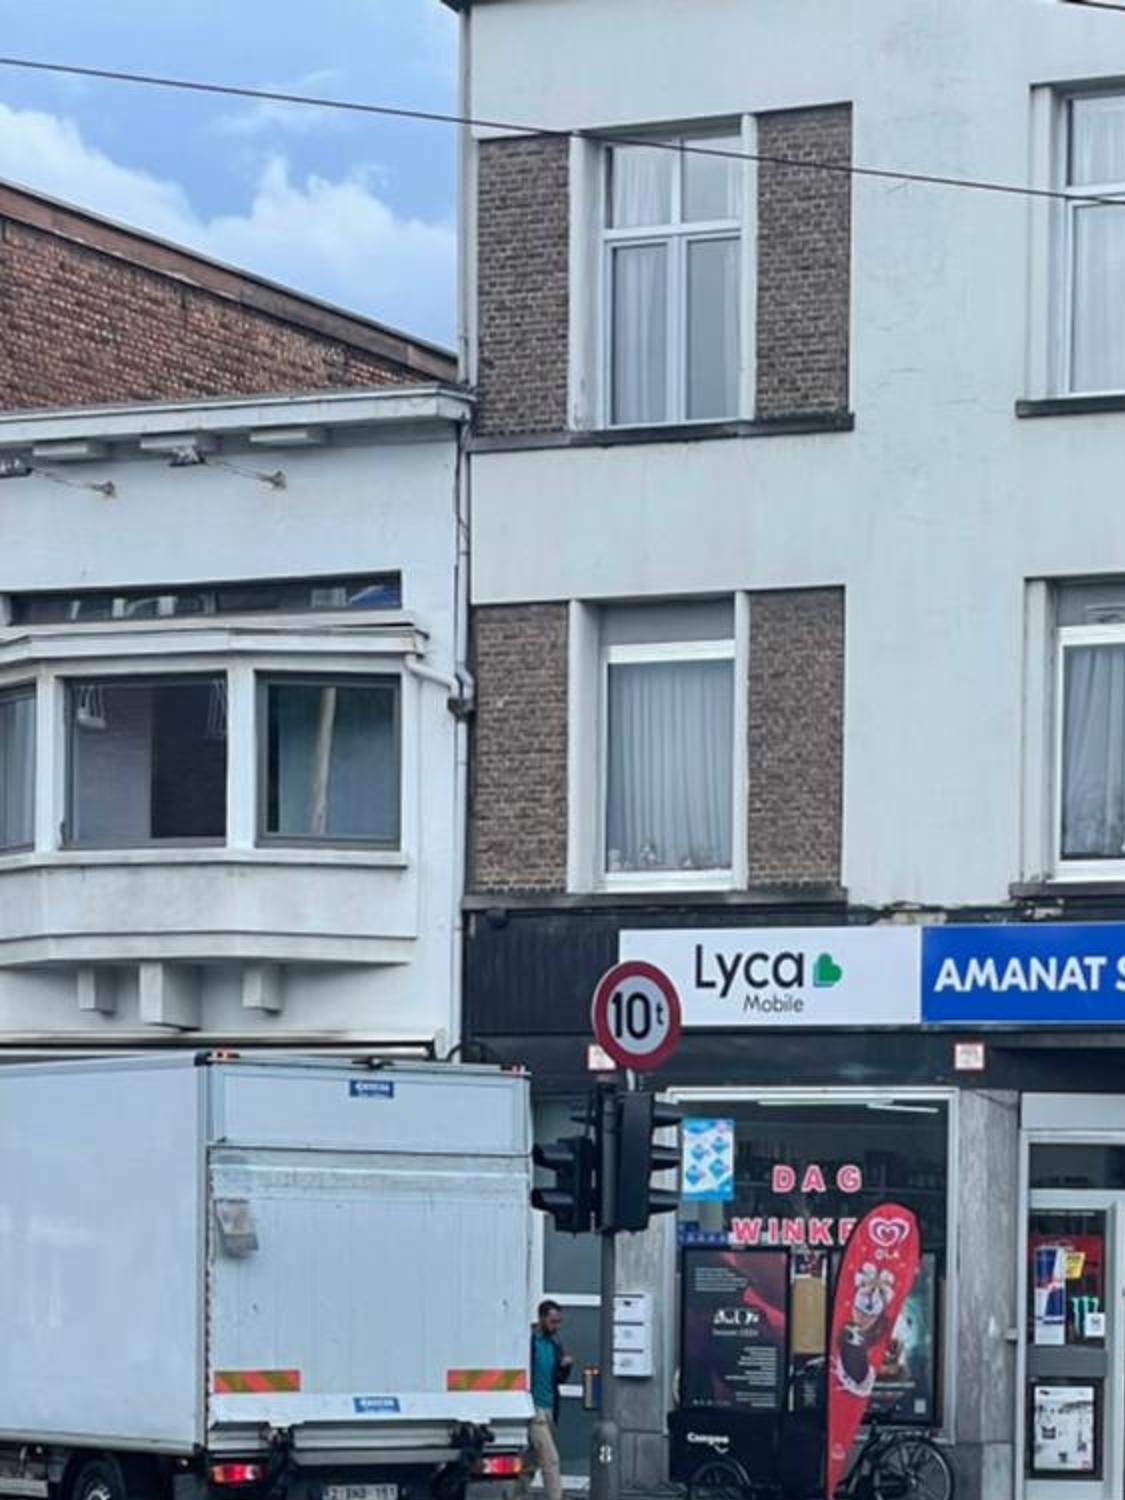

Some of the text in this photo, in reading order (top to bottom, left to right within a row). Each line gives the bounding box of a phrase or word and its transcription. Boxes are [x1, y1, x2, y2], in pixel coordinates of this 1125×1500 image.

[695, 943, 804, 998] Lyca
[933, 956, 1107, 992] AMANAT
[612, 991, 664, 1041] 10 t
[743, 994, 804, 1013] Mobile
